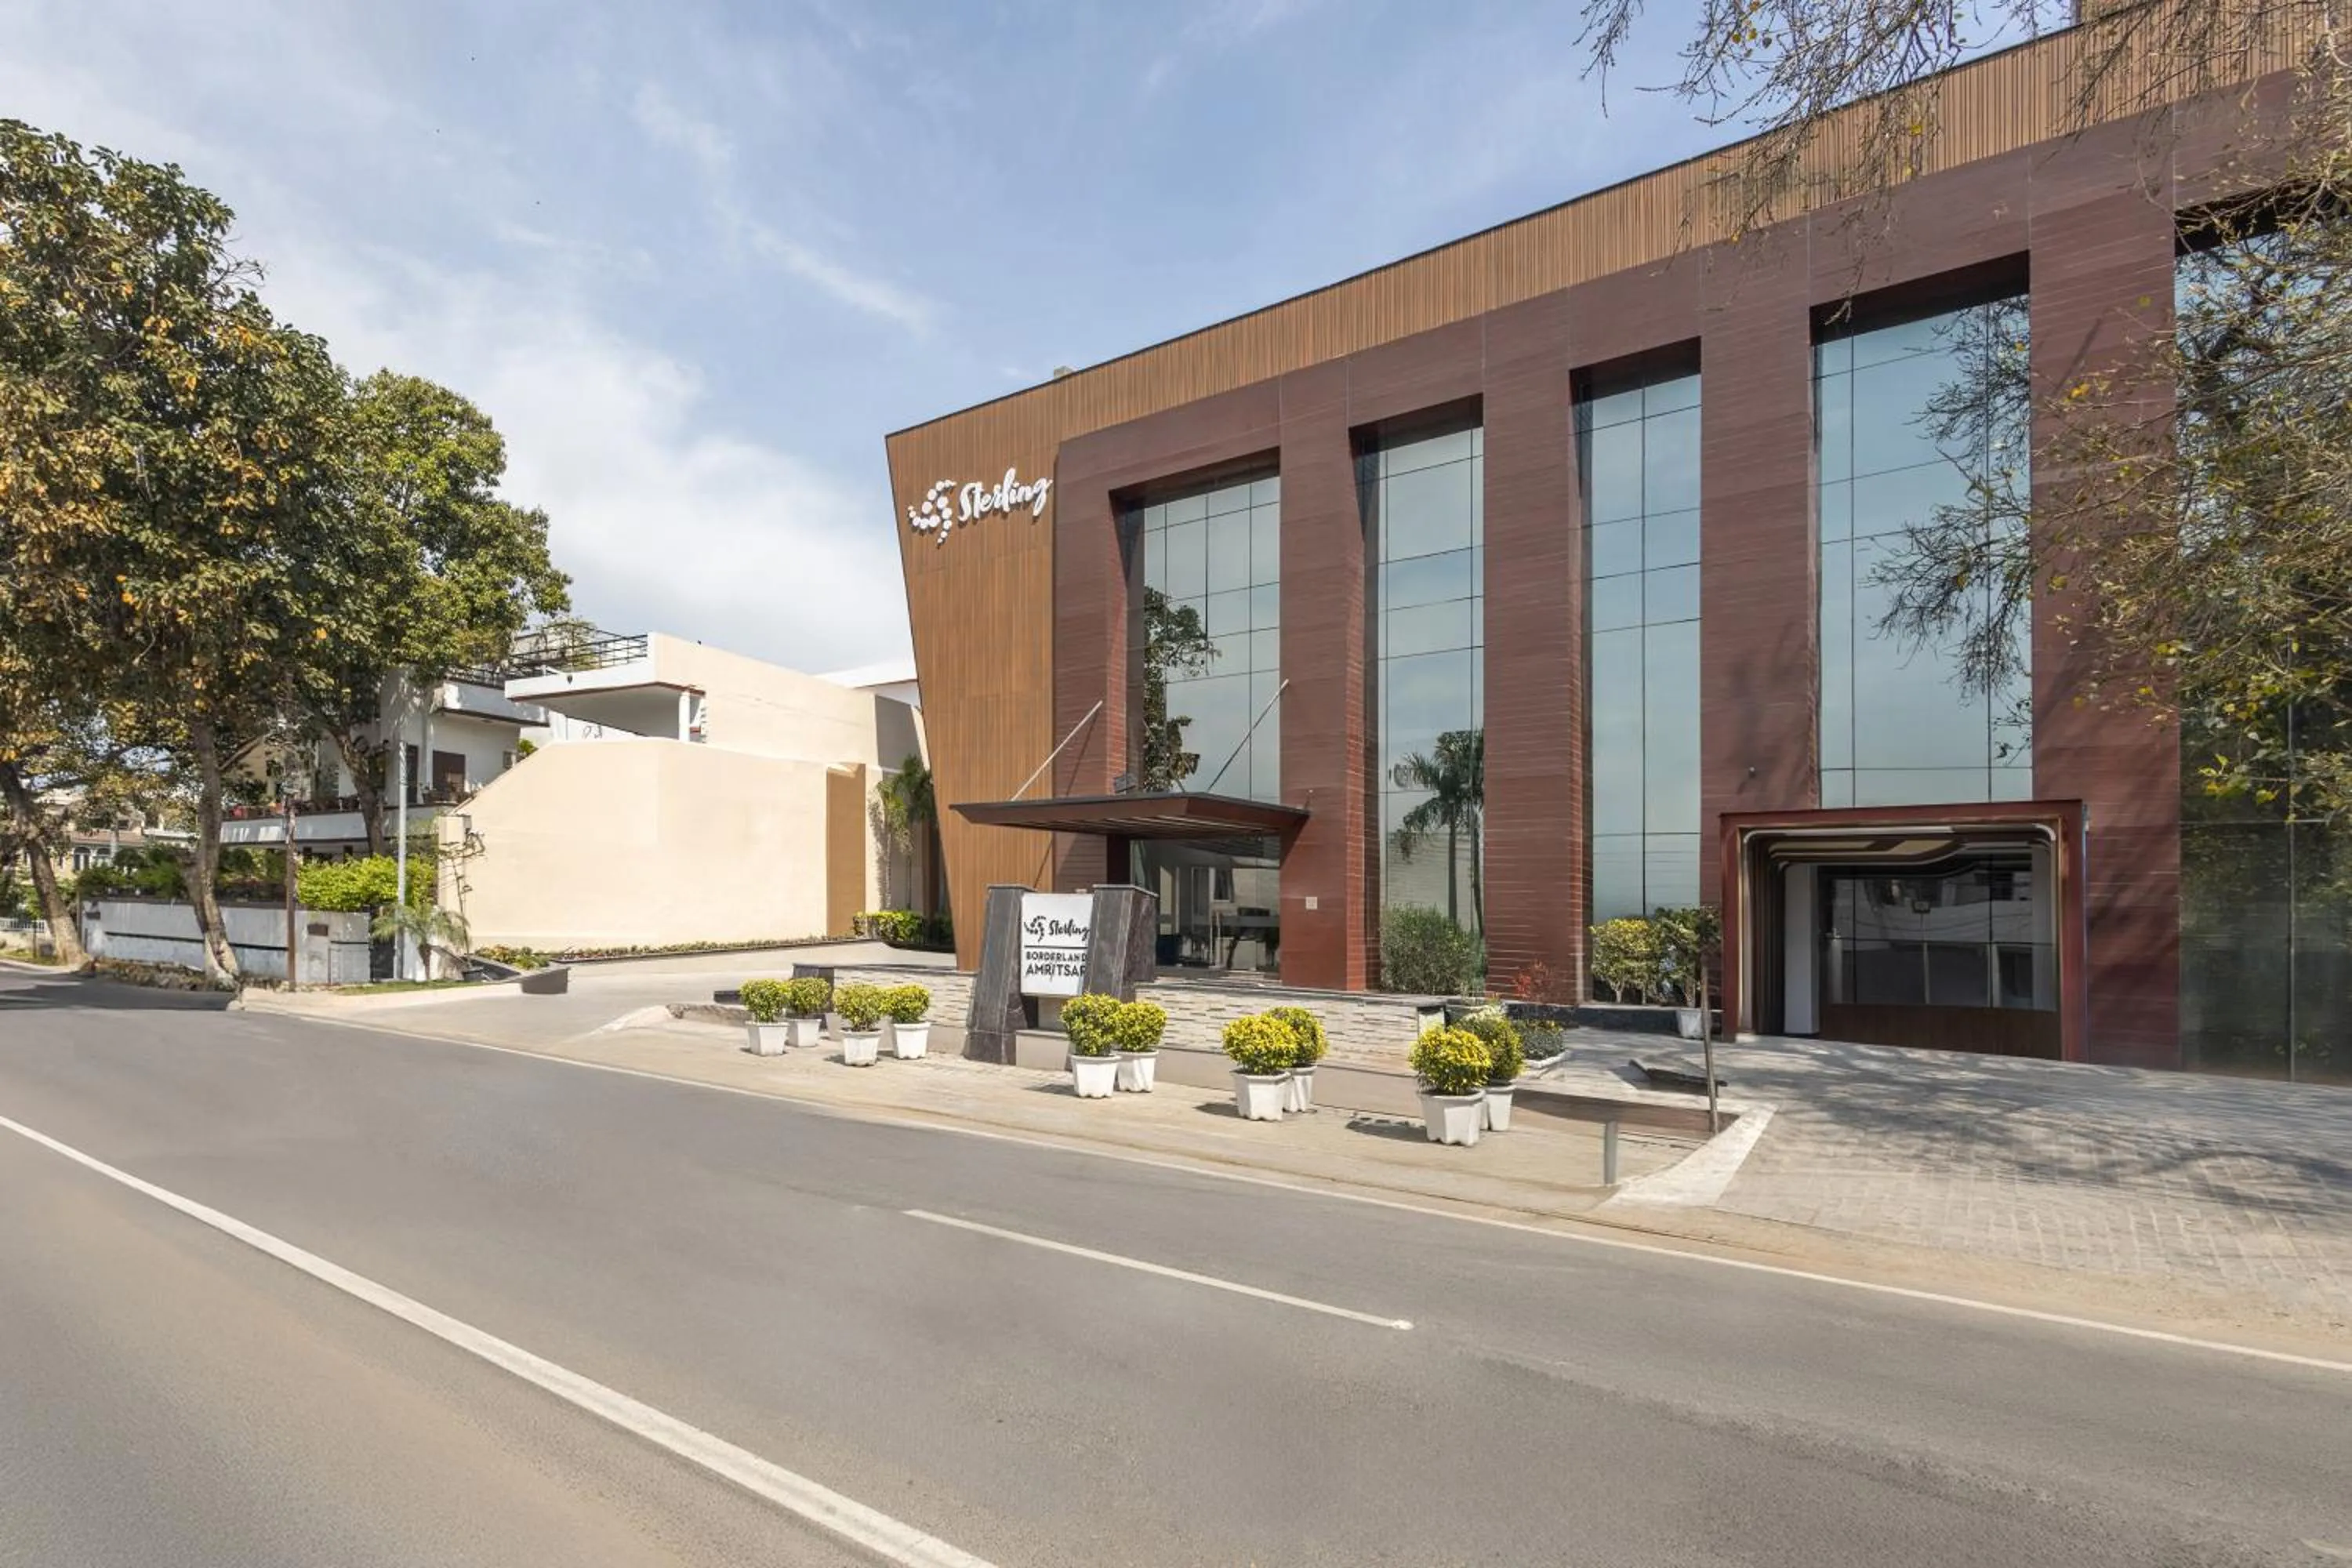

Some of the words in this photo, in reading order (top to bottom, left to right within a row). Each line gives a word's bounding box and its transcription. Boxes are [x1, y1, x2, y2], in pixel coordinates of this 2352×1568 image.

[957, 467, 1054, 522] Sterling
[1048, 918, 1091, 942] Sterling
[1026, 951, 1088, 962] BORDERLAND
